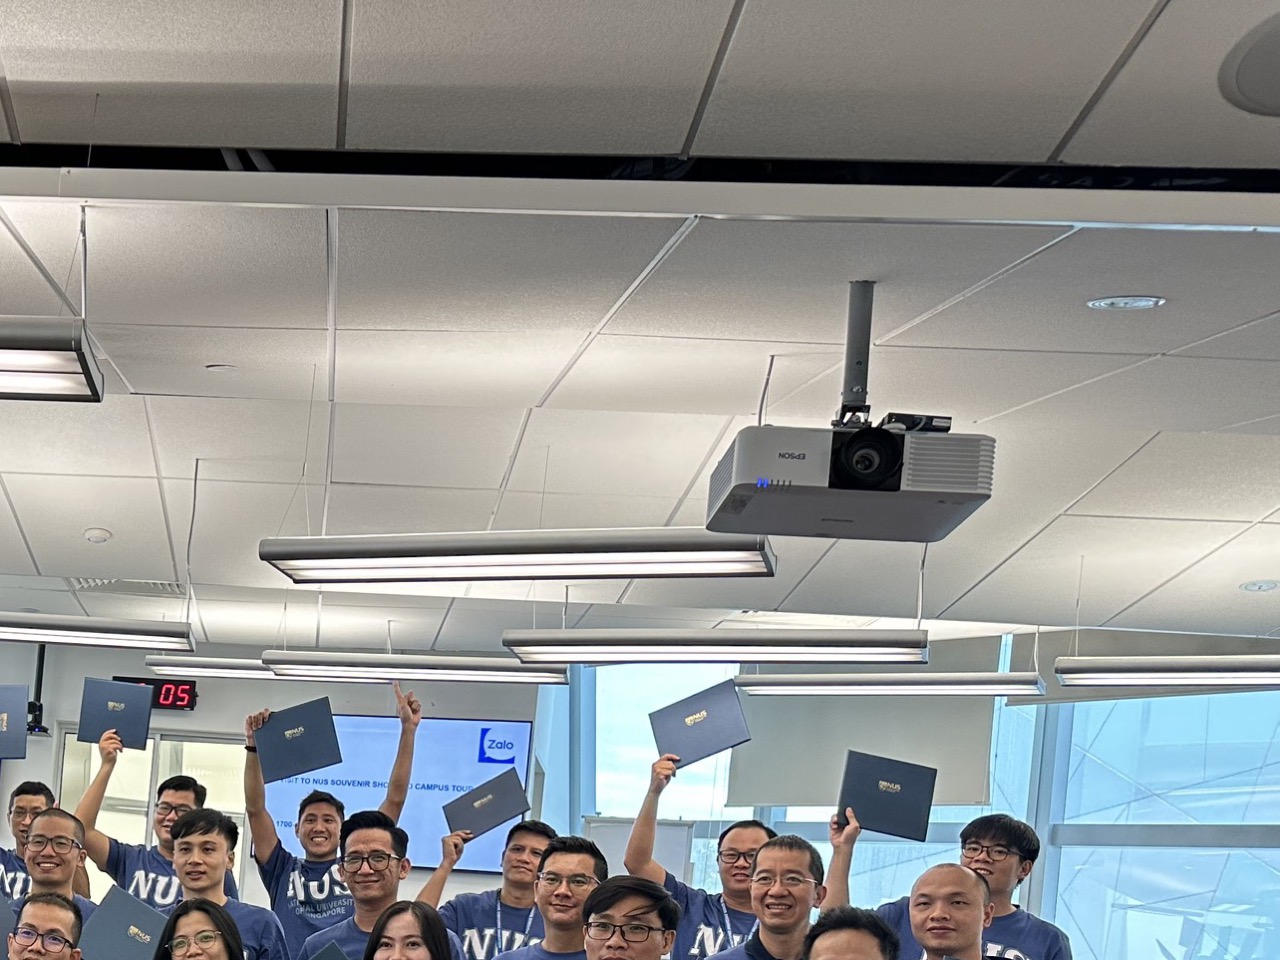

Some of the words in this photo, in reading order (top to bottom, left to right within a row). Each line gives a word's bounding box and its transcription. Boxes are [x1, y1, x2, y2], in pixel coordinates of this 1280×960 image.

[778, 451, 806, 460] EPSON
[159, 684, 190, 706] 05
[487, 739, 514, 750] Zalo
[312, 778, 329, 786] NUS
[330, 778, 370, 788] SOUVENIR
[415, 783, 449, 792] CAMPUS
[128, 870, 181, 906] NU
